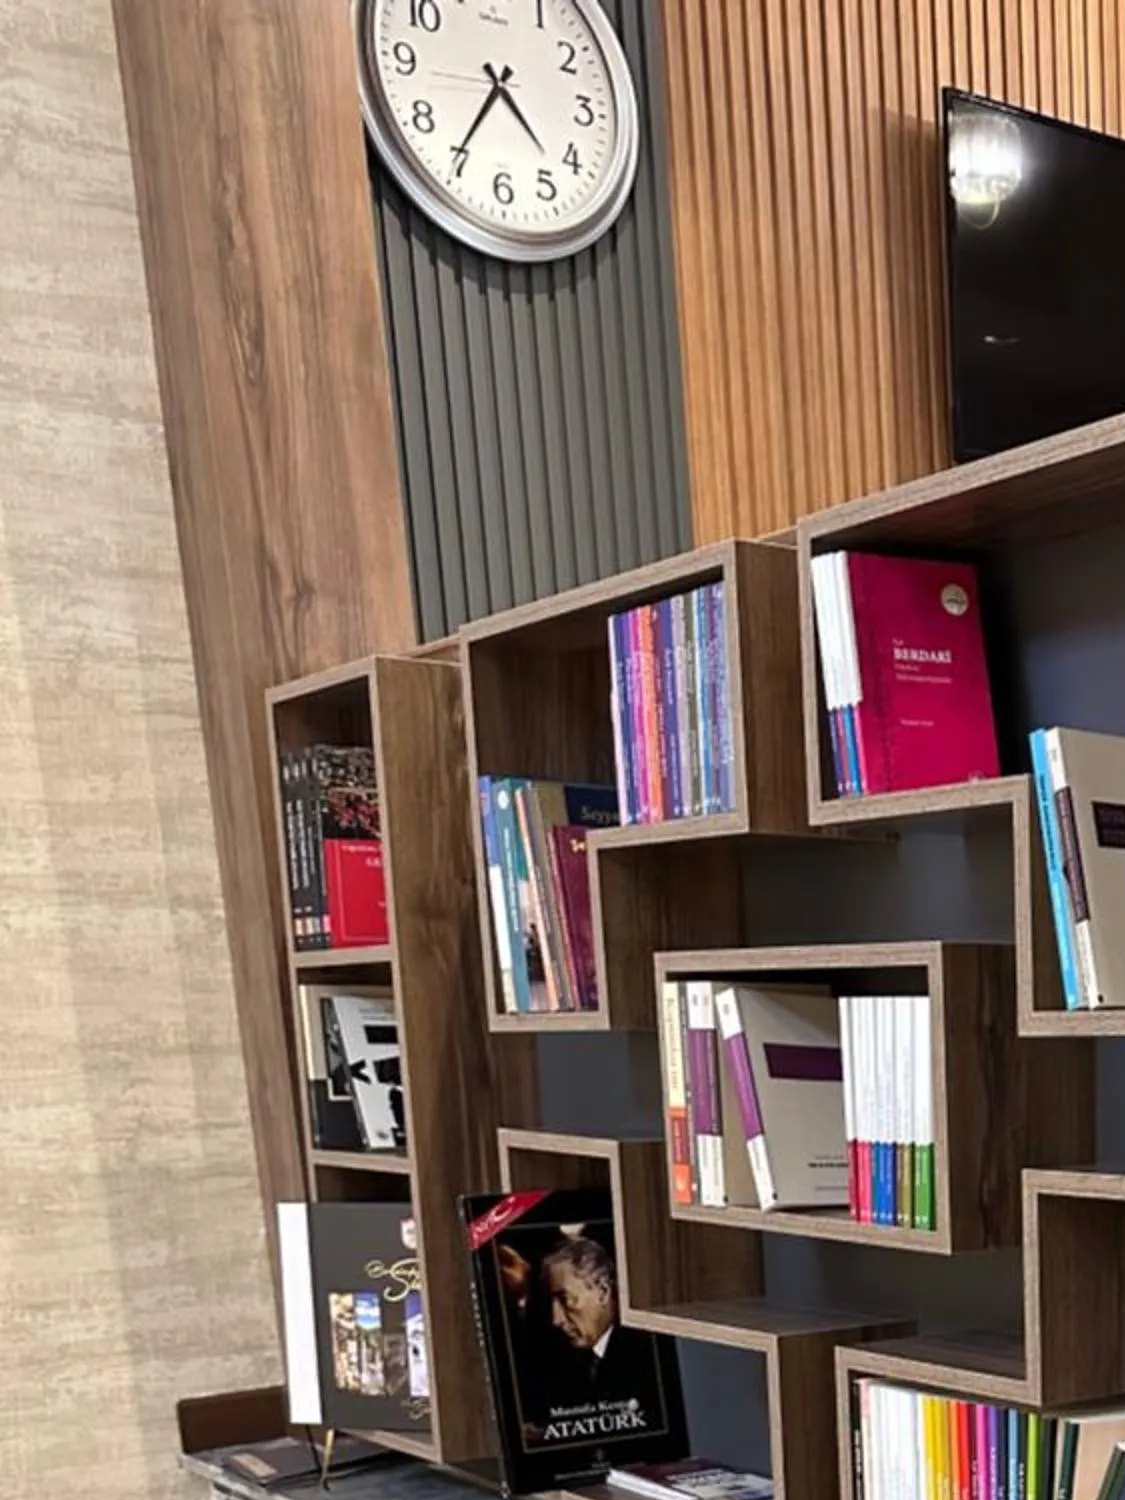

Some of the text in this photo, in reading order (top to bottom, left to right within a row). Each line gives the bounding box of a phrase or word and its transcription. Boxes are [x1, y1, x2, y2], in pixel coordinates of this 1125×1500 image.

[408, 0, 441, 32] 10
[535, 0, 545, 28] 1
[393, 42, 416, 75] 9
[557, 41, 577, 75] 2
[412, 100, 435, 134] 8
[573, 95, 594, 127] 3
[450, 146, 469, 177] 7
[562, 142, 582, 175] 4
[493, 172, 514, 204] 6
[536, 170, 556, 201] 5
[544, 1411, 646, 1440] ATATÜRK
